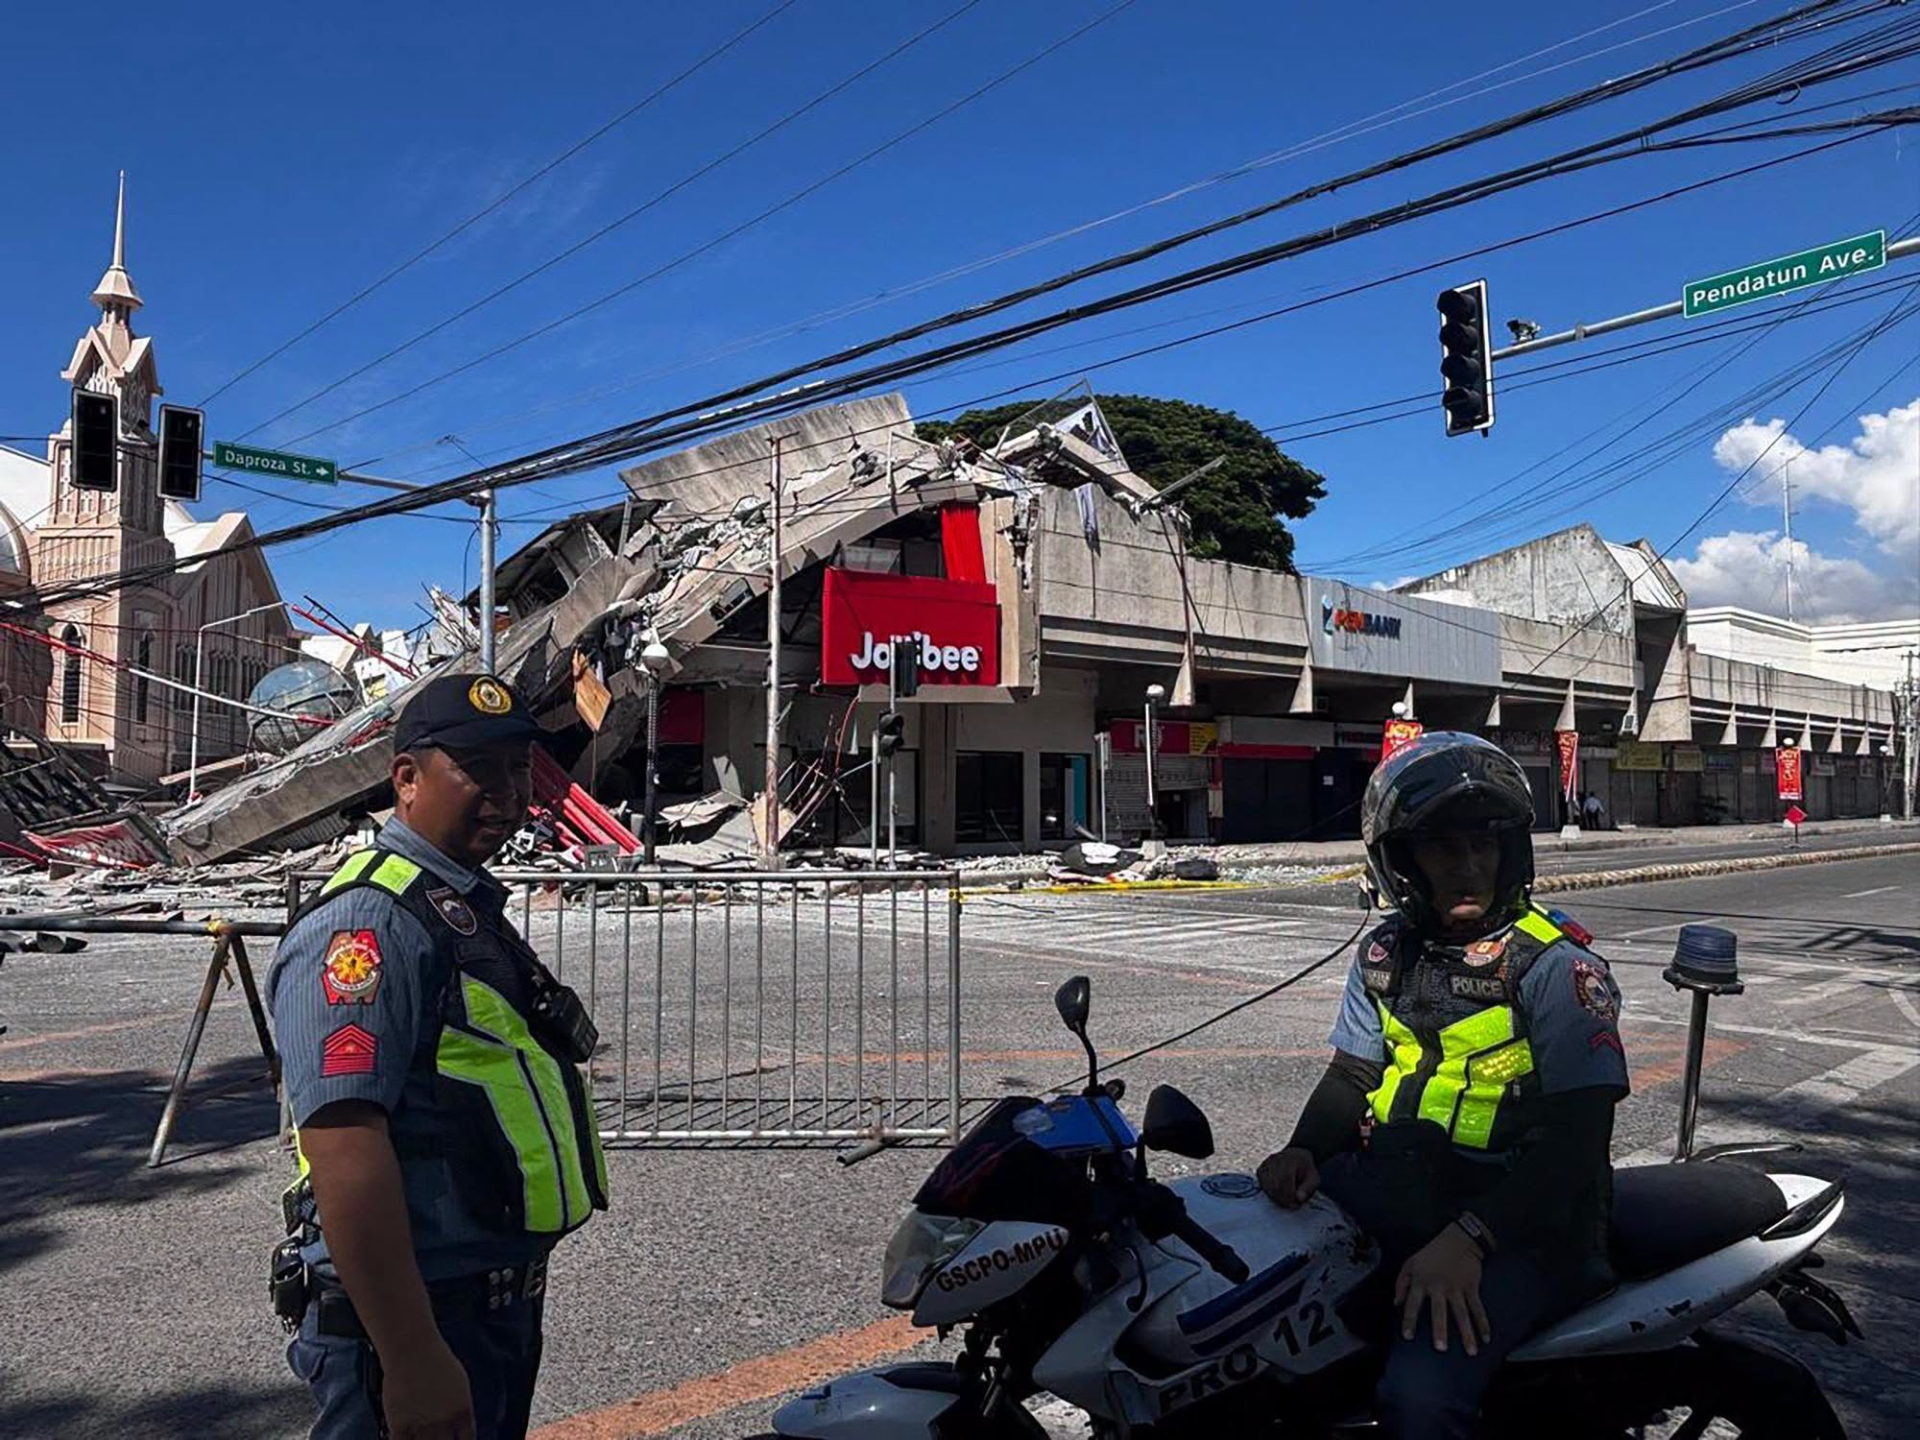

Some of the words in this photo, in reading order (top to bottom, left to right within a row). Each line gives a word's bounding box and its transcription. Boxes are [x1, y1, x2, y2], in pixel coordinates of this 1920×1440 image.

[1693, 264, 1806, 307] Pendatun
[1819, 248, 1874, 275] Ave.
[225, 449, 287, 470] Daproza
[292, 461, 311, 475] St.
[1452, 975, 1503, 998] POLICE
[936, 1227, 1065, 1293] GSCPO-MPU
[1158, 1343, 1259, 1415] PRO
[1272, 1300, 1337, 1357] 12
